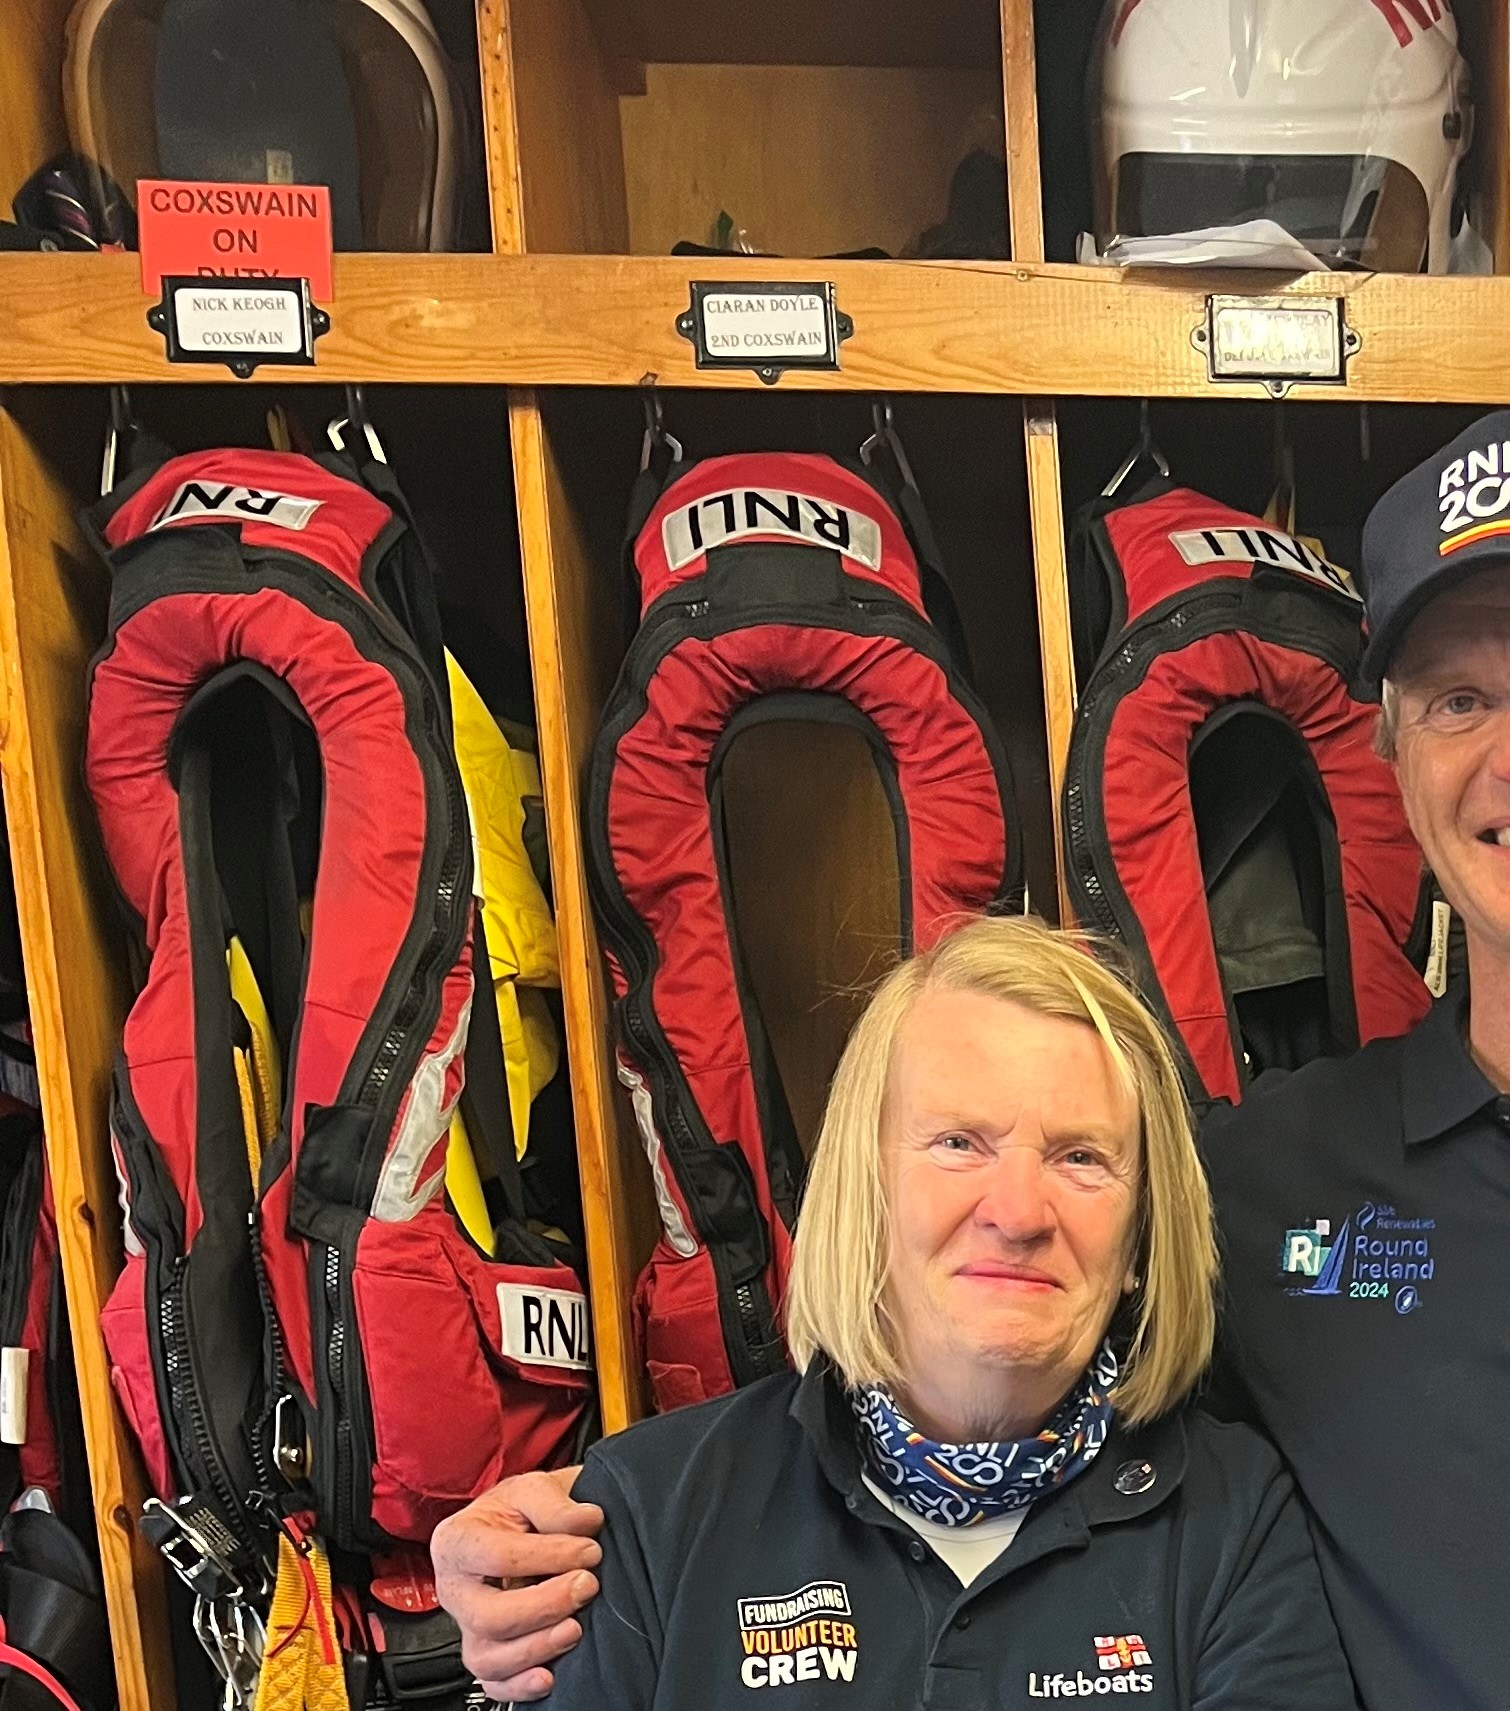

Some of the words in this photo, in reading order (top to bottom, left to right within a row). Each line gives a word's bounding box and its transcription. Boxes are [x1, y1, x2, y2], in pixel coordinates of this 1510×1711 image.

[150, 188, 317, 218] COXSWAIN
[213, 228, 258, 254] ON
[193, 297, 229, 311] NICK
[233, 297, 287, 311] KEOGH
[707, 300, 765, 314] CIARAN
[770, 294, 819, 312] DOYLE
[202, 330, 284, 346] COXSWAIN
[711, 334, 740, 348] 2ND
[743, 330, 822, 347] COXSWAIN
[688, 491, 850, 550] RNLI
[1200, 530, 1350, 594] RNLI
[1354, 1235, 1428, 1257] Round
[1351, 1257, 1435, 1280] Ireland
[1350, 1282, 1390, 1298] 2024
[744, 1587, 845, 1625] FUNDRAISING
[741, 1620, 858, 1655] VOLUNTEER
[740, 1646, 858, 1689] CREW
[1028, 1669, 1154, 1698] Lifeboats
